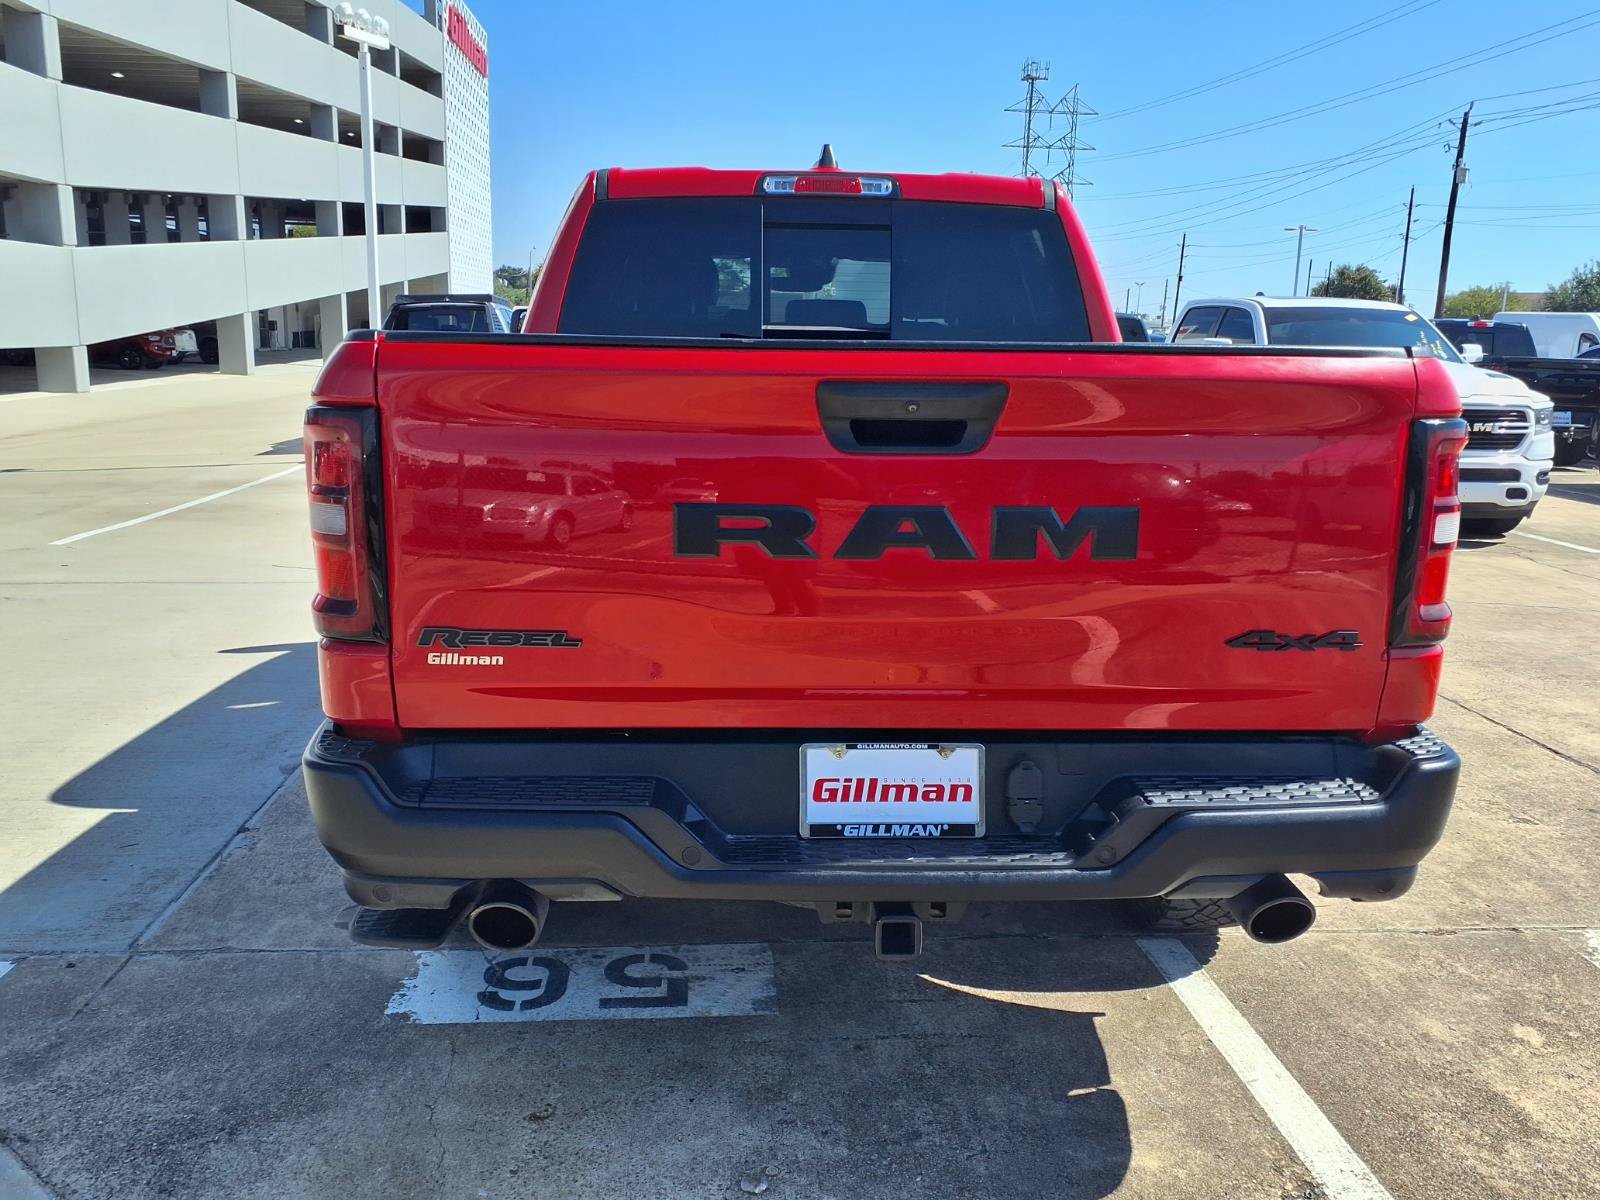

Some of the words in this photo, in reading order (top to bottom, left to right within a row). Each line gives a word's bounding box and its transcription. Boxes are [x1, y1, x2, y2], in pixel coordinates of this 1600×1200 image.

[448, 5, 488, 78] Gillman
[673, 503, 1139, 560] RAM
[416, 627, 582, 649] REBEL
[1224, 630, 1364, 651] 4x4
[427, 652, 504, 665] Gillman
[812, 777, 973, 803] Gillman
[843, 824, 942, 837] GILLMAN
